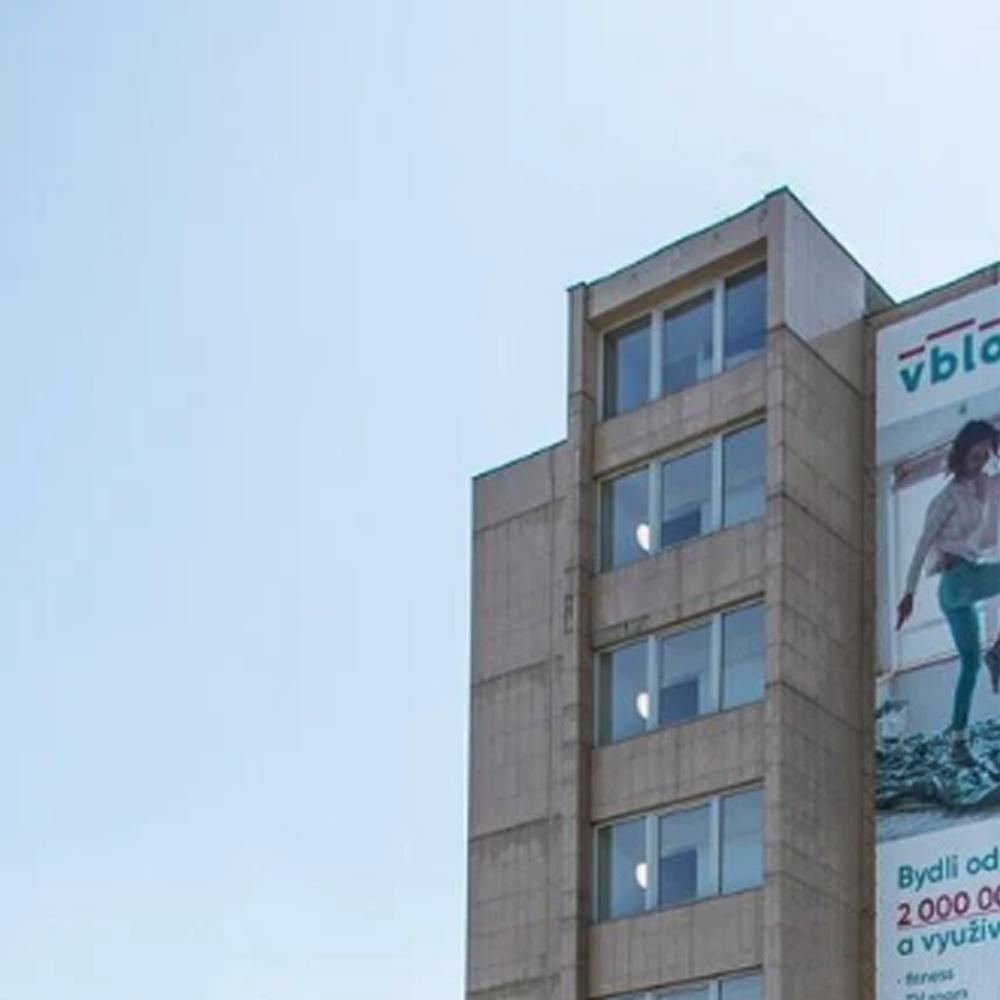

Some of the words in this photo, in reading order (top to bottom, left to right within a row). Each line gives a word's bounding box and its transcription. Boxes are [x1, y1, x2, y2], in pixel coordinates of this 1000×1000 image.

[966, 846, 999, 875] od
[897, 902, 911, 927] 2
[917, 891, 970, 922] 000
[897, 937, 914, 956] a
